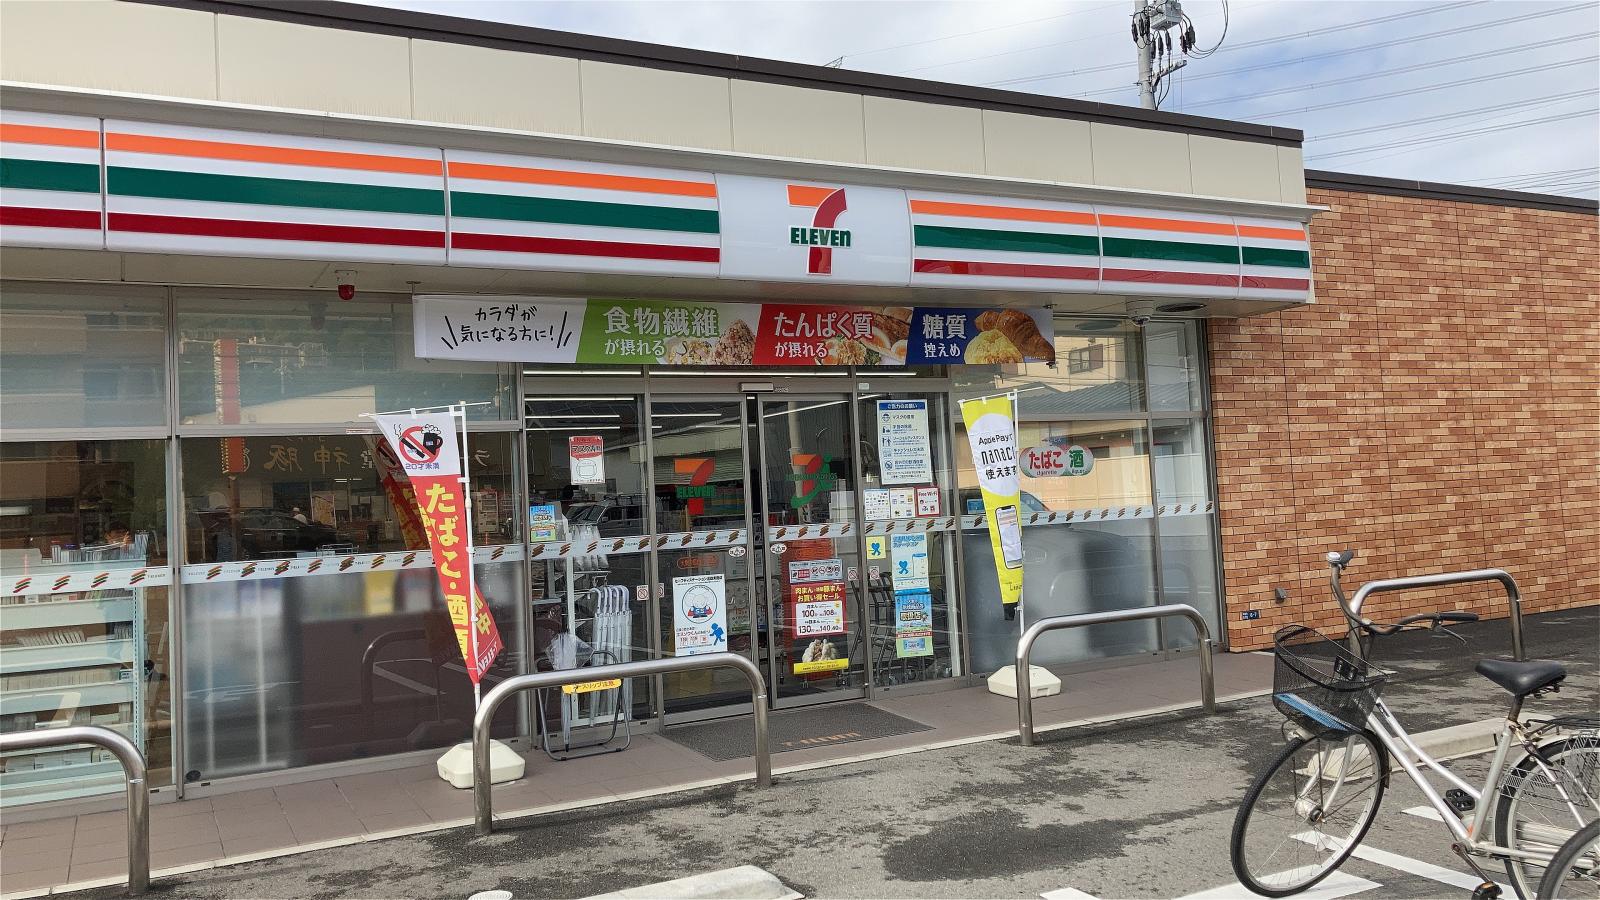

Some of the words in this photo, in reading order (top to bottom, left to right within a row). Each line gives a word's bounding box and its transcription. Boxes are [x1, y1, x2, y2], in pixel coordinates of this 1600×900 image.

[475, 304, 538, 322] カラダが
[603, 306, 720, 337] 食物繊維
[460, 324, 555, 343] 気になる方に!
[773, 312, 874, 340] たんぱく質
[922, 314, 967, 340] 糖質
[604, 339, 665, 357] が摂れる
[774, 342, 828, 358] が摂れる
[924, 342, 961, 358] 控えめ
[1029, 449, 1063, 469] たばこ
[1069, 449, 1084, 468] 酒
